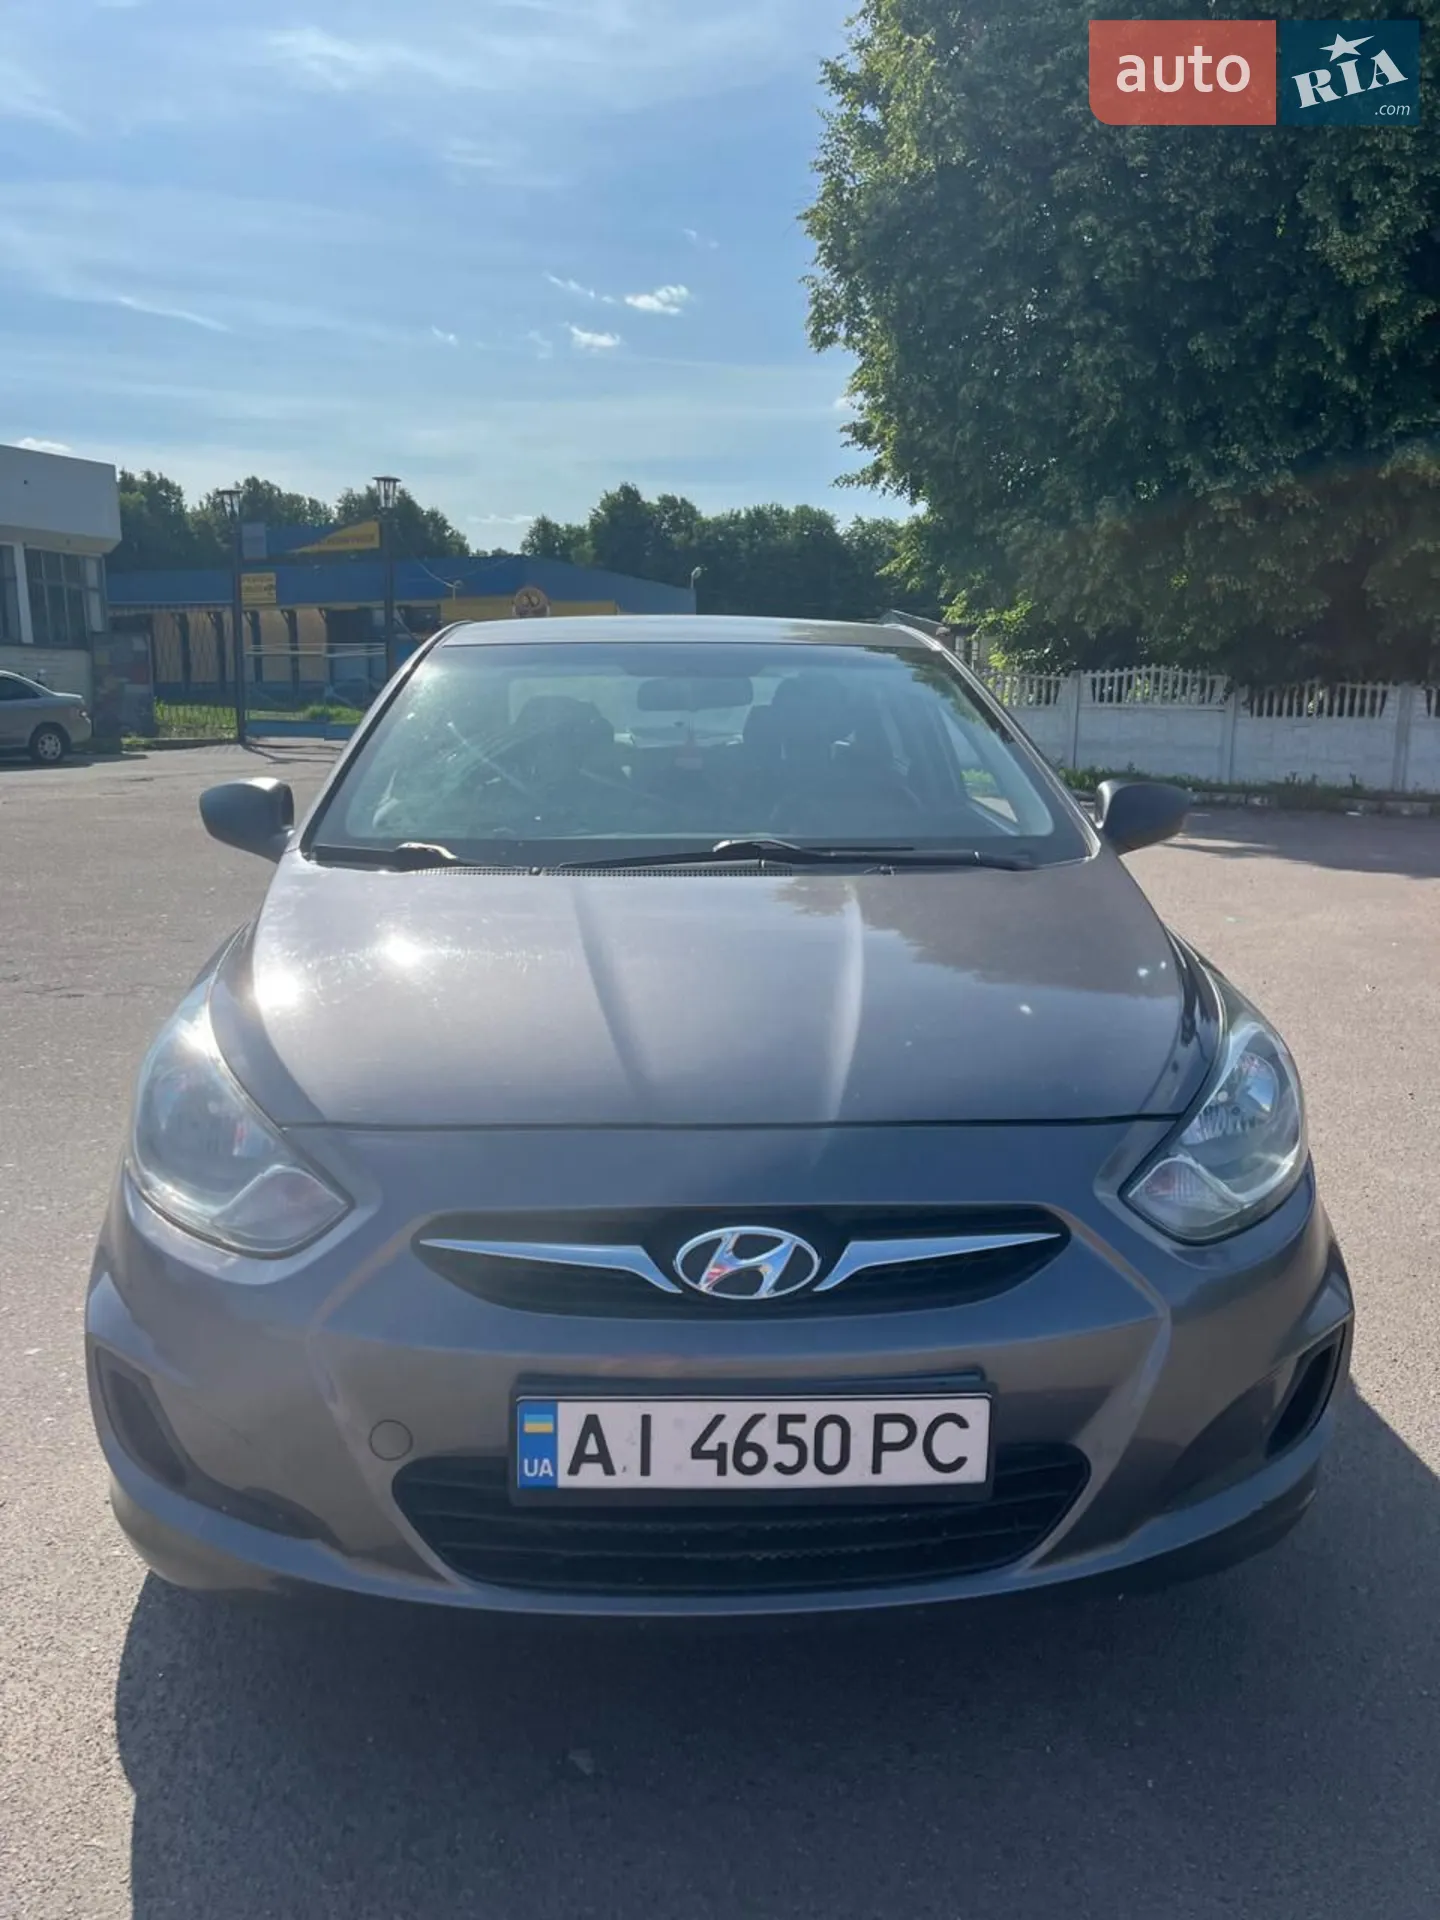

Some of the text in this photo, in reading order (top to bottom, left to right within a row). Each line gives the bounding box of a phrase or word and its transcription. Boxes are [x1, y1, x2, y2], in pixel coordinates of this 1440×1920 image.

[567, 1412, 970, 1477] AI 4650 PC
[524, 1459, 554, 1477] UA
